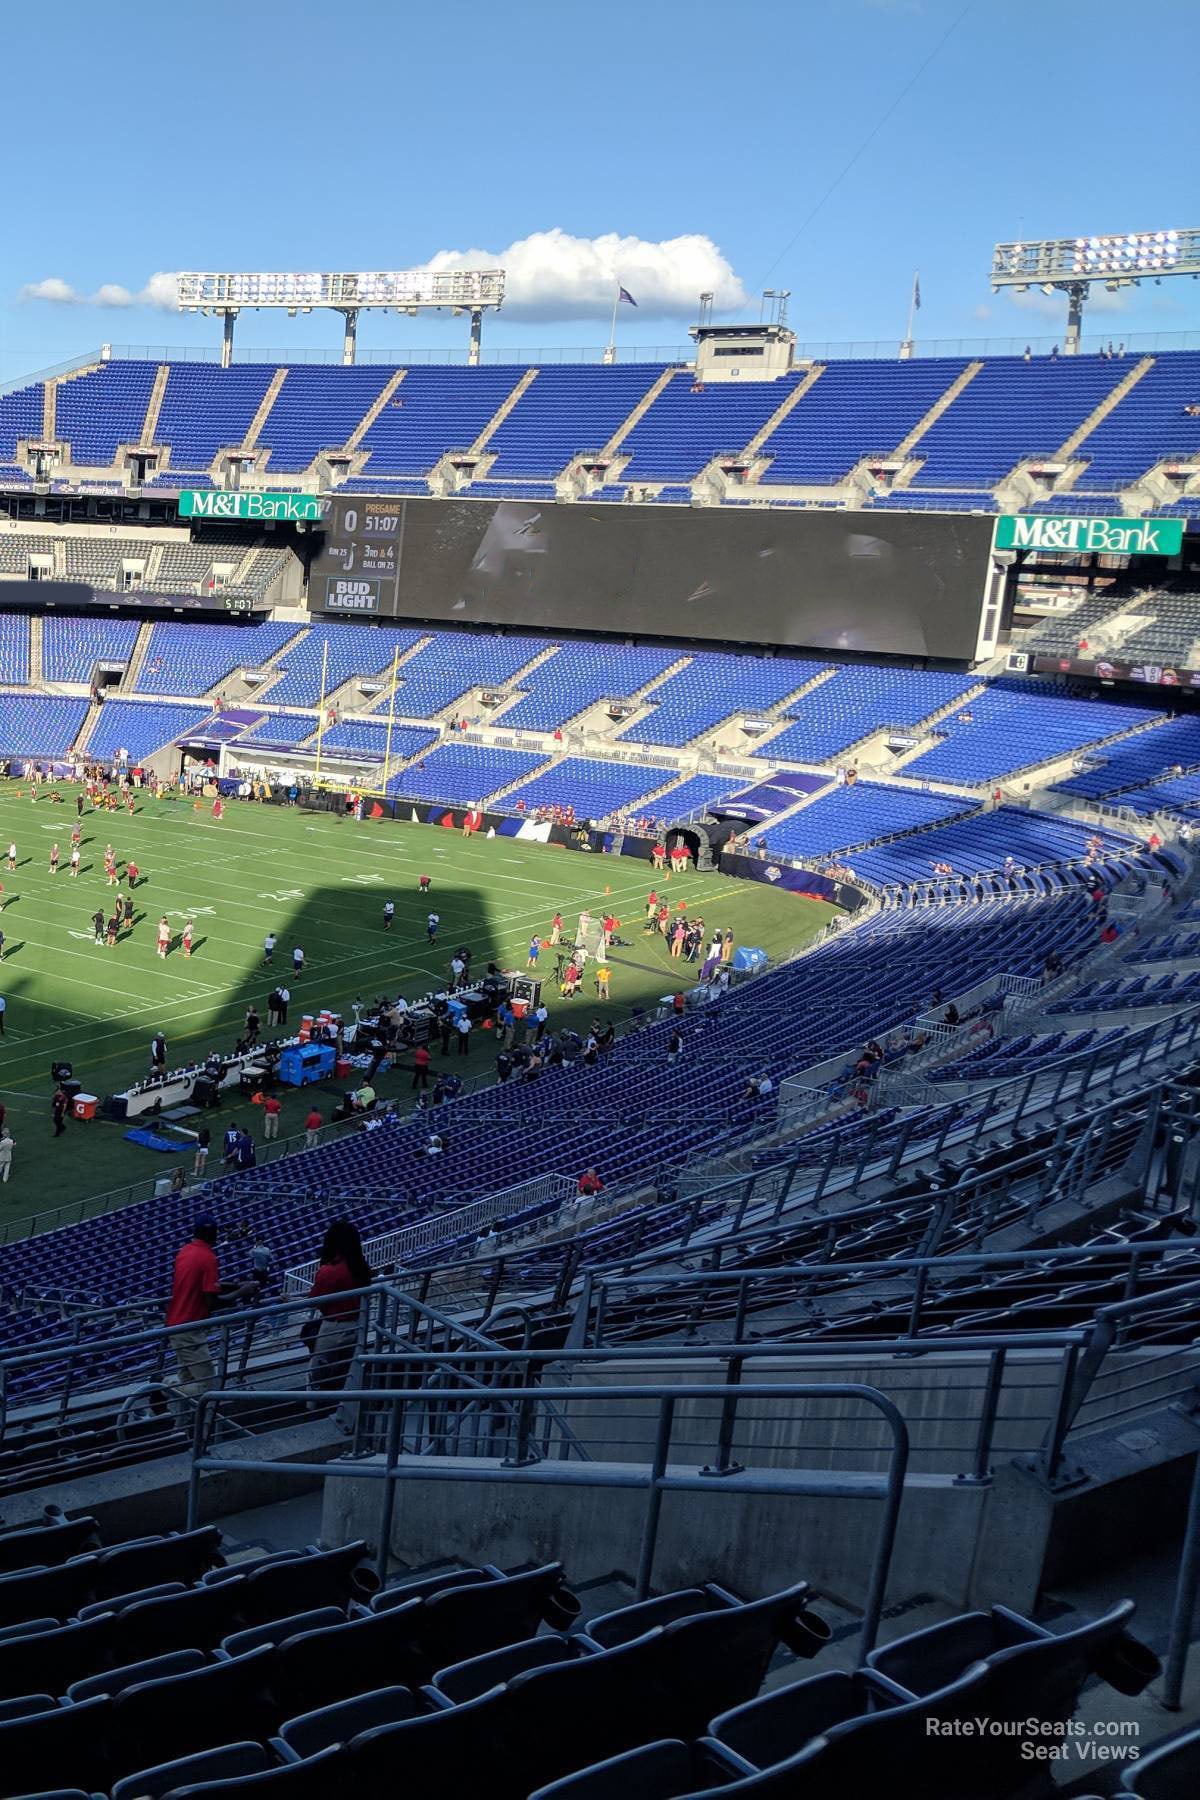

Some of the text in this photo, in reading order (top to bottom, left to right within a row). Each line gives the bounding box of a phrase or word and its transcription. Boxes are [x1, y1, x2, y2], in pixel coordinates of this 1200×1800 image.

[191, 492, 247, 516] M&T
[365, 503, 401, 515] PREGAME
[345, 510, 358, 532] 0
[364, 516, 399, 532] 51:07
[1010, 517, 1161, 552] M&T Bank
[364, 545, 379, 558] 3RD
[386, 546, 394, 558] 4
[363, 560, 395, 570] BALL ON 25
[335, 581, 371, 596] BUD
[328, 593, 376, 609] LIGHT
[76, 1103, 85, 1114] G
[228, 1133, 238, 1143] 15
